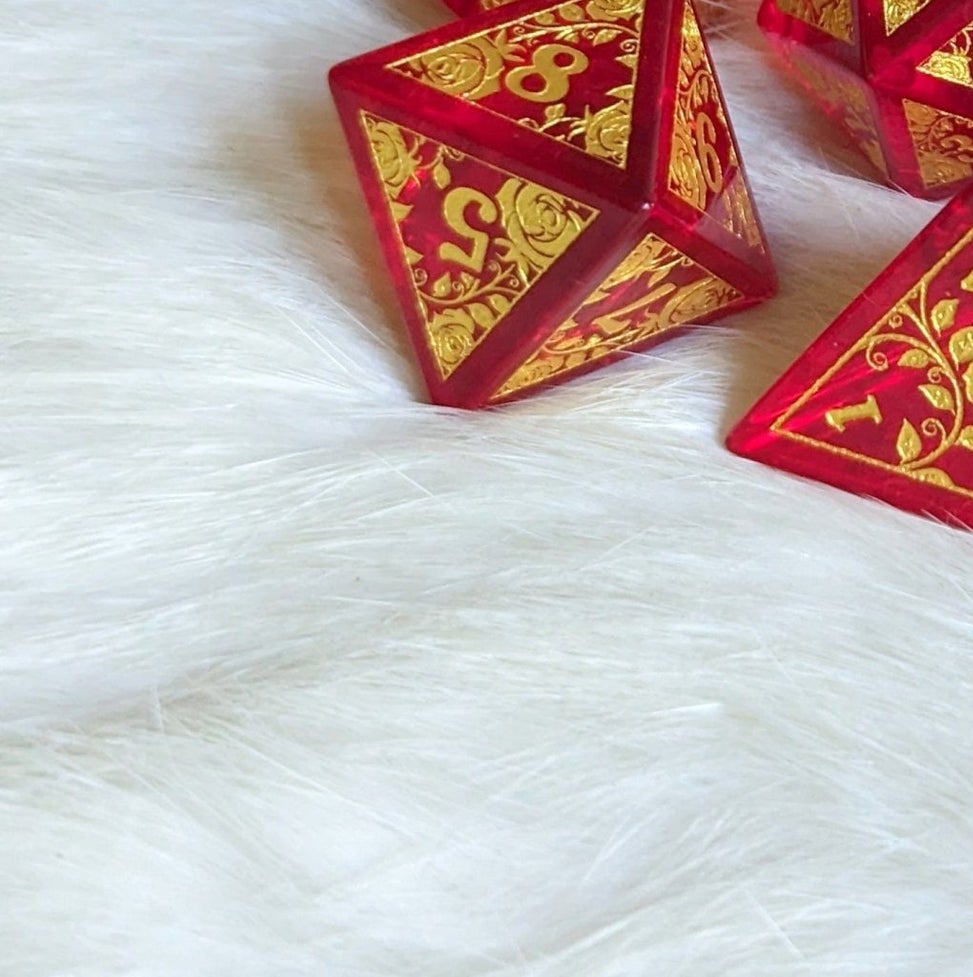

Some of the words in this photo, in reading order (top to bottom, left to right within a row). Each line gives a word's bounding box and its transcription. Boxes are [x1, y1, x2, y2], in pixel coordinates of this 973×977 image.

[505, 43, 590, 104] 8
[438, 186, 498, 273] 5
[825, 394, 883, 433] 1
